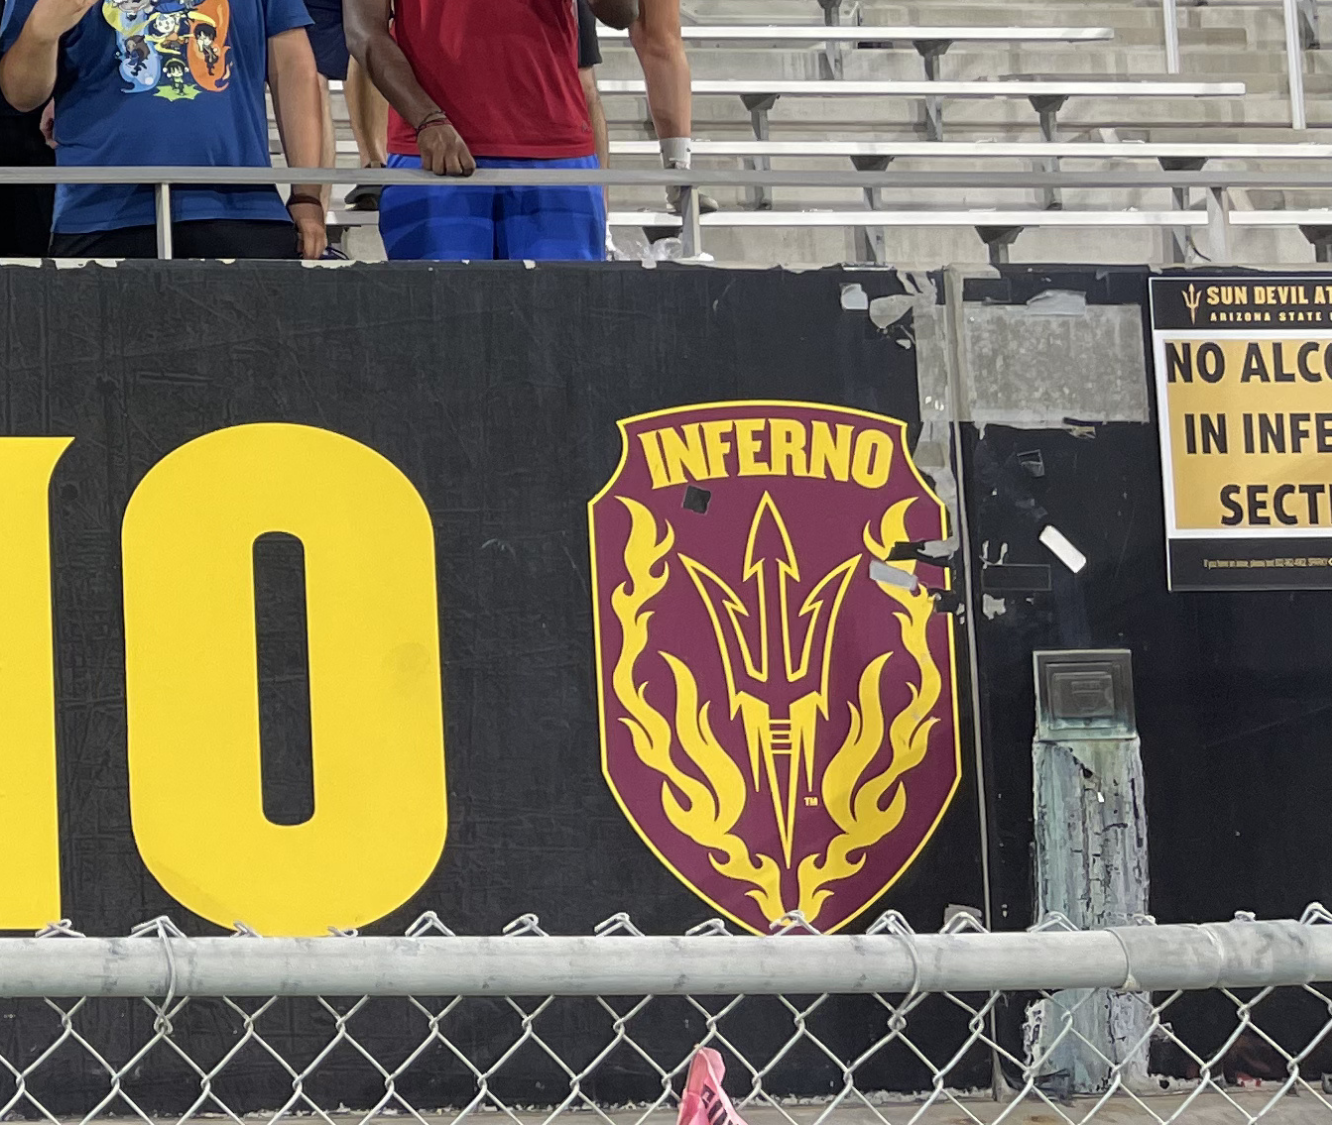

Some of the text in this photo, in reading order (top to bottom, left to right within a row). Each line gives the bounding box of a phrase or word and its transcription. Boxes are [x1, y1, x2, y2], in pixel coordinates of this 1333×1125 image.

[1206, 285, 1248, 305] SUN
[1254, 285, 1309, 305] DEVIL
[1210, 311, 1322, 322] ARIZONA STATE
[1164, 342, 1226, 383] NO
[637, 418, 894, 489] INFERNO
[1184, 412, 1332, 454] IN INFE
[1219, 484, 1332, 526] SECT
